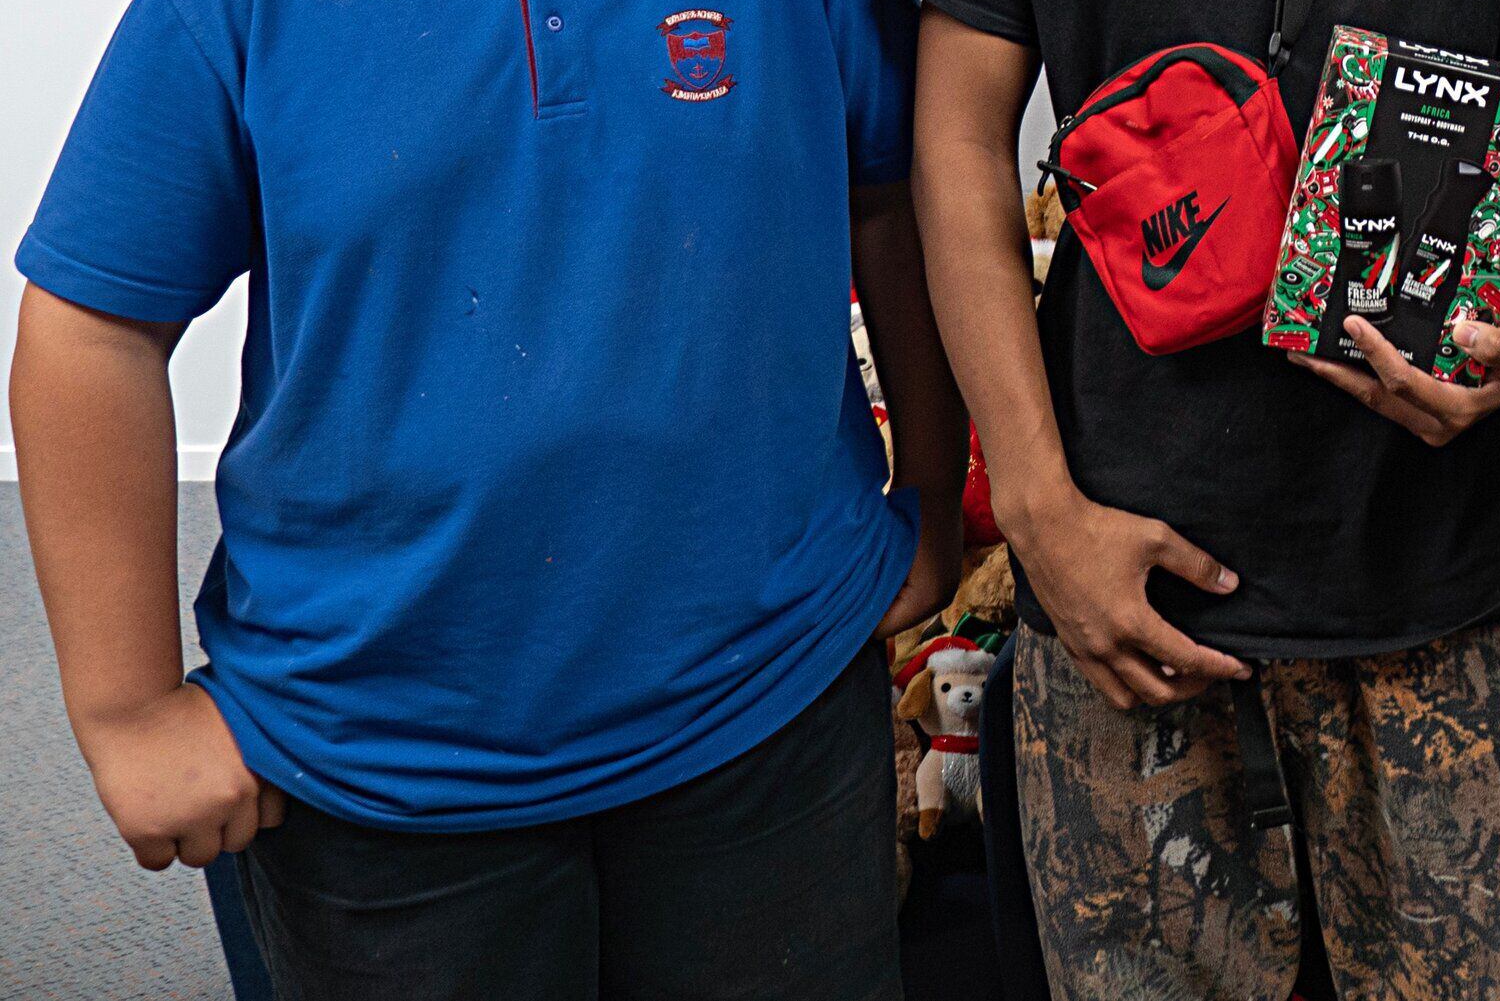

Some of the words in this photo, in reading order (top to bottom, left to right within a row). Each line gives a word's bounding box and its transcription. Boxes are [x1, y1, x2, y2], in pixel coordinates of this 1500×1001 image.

[1399, 40, 1490, 66] LYNX
[1394, 66, 1490, 108] LYNX
[1420, 104, 1451, 119] AFRICA
[1400, 112, 1432, 125] BODYSPRAY
[1436, 120, 1466, 133] BODYWASH
[1408, 131, 1429, 142] THE
[1141, 190, 1201, 257] NIKE
[1344, 216, 1396, 232] LYNX
[1421, 233, 1457, 254] LYNX
[1348, 287, 1380, 300] FRESH
[1347, 297, 1388, 309] FRAGRANCE
